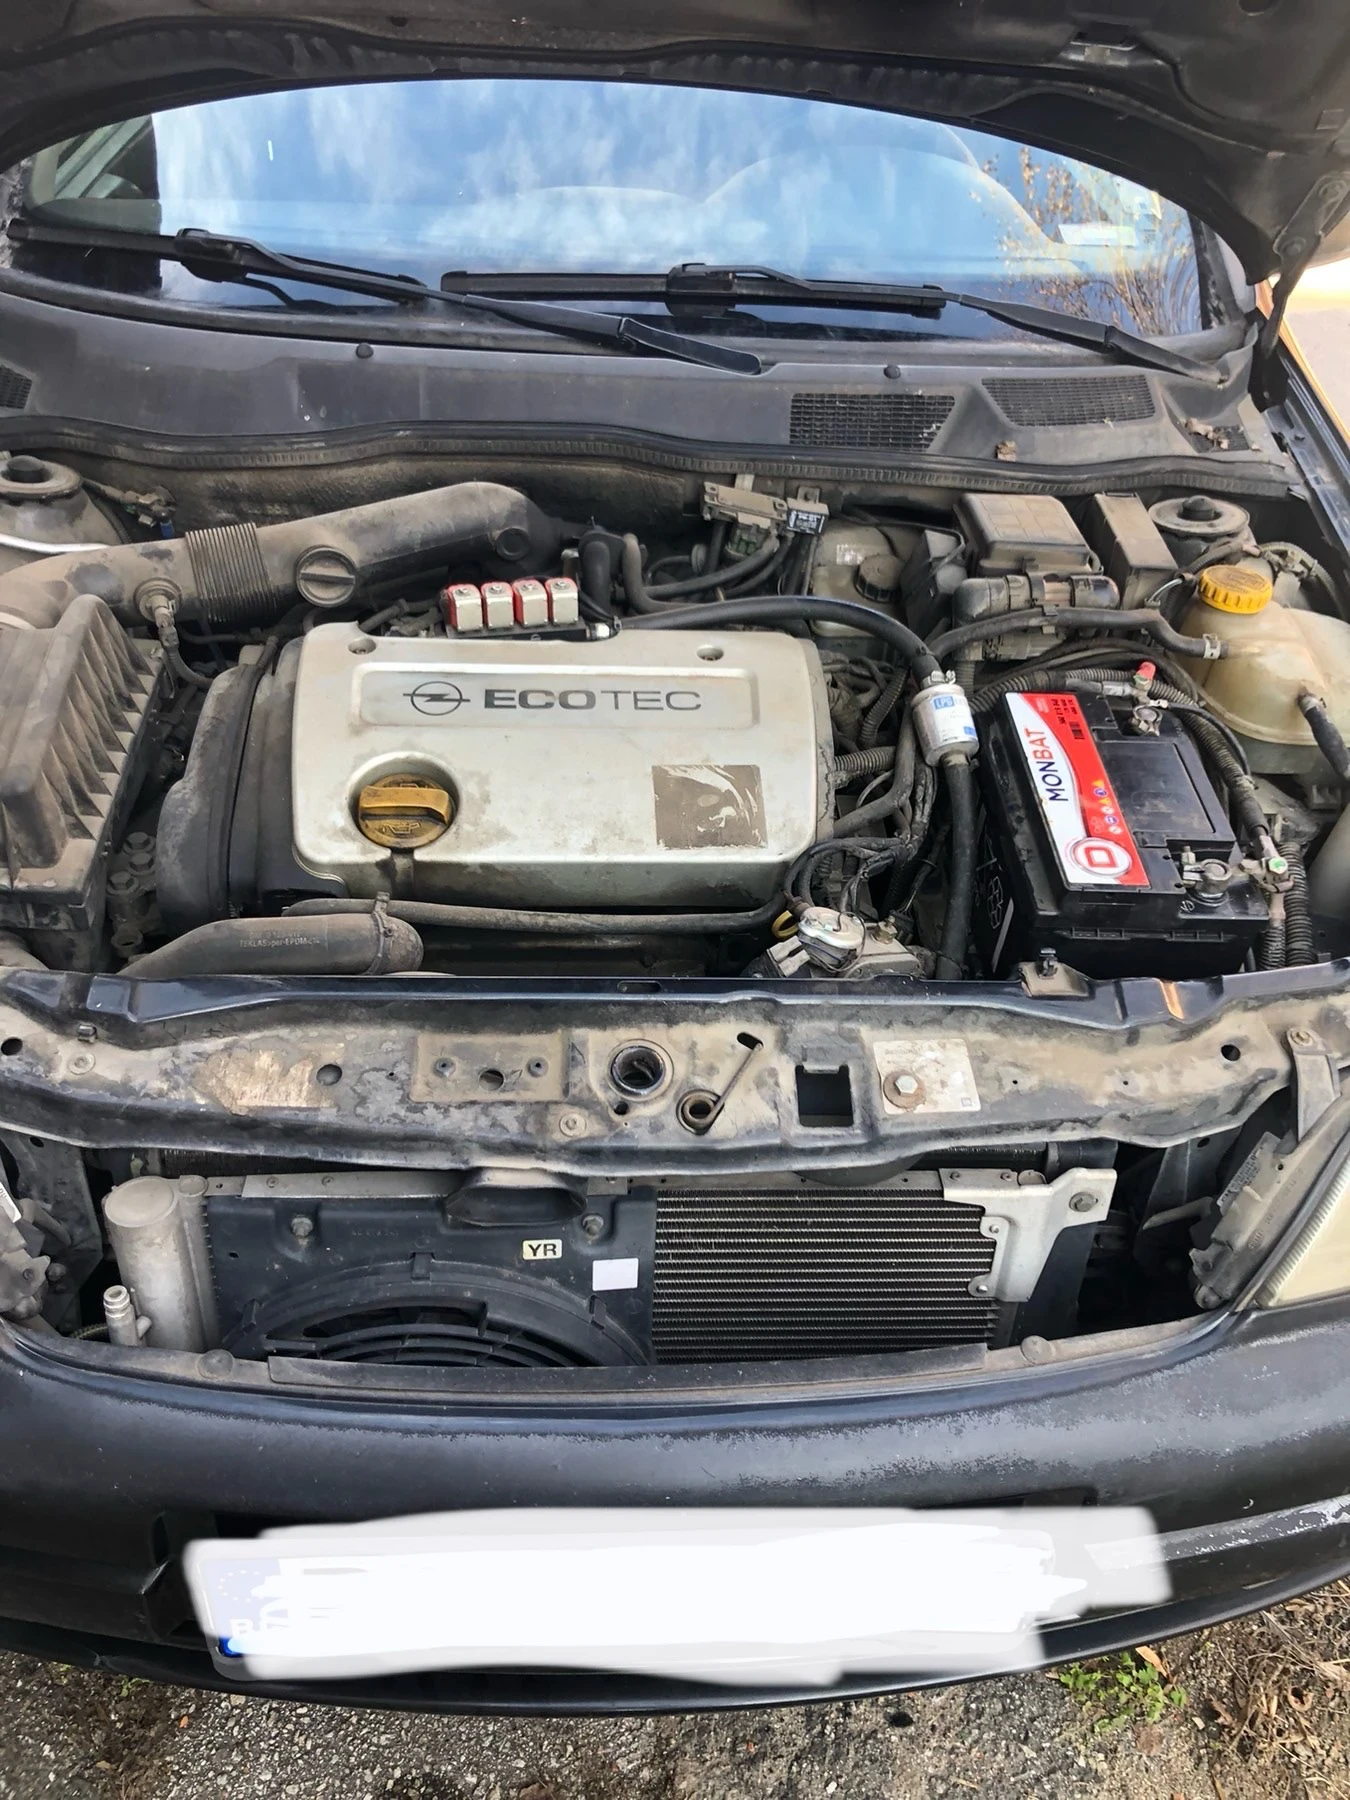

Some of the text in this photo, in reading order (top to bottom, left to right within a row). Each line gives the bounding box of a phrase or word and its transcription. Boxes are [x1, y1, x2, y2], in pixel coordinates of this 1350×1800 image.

[484, 689, 702, 711] ECOTEC
[1024, 728, 1069, 801] MONBAT
[528, 1243, 557, 1257] YR
